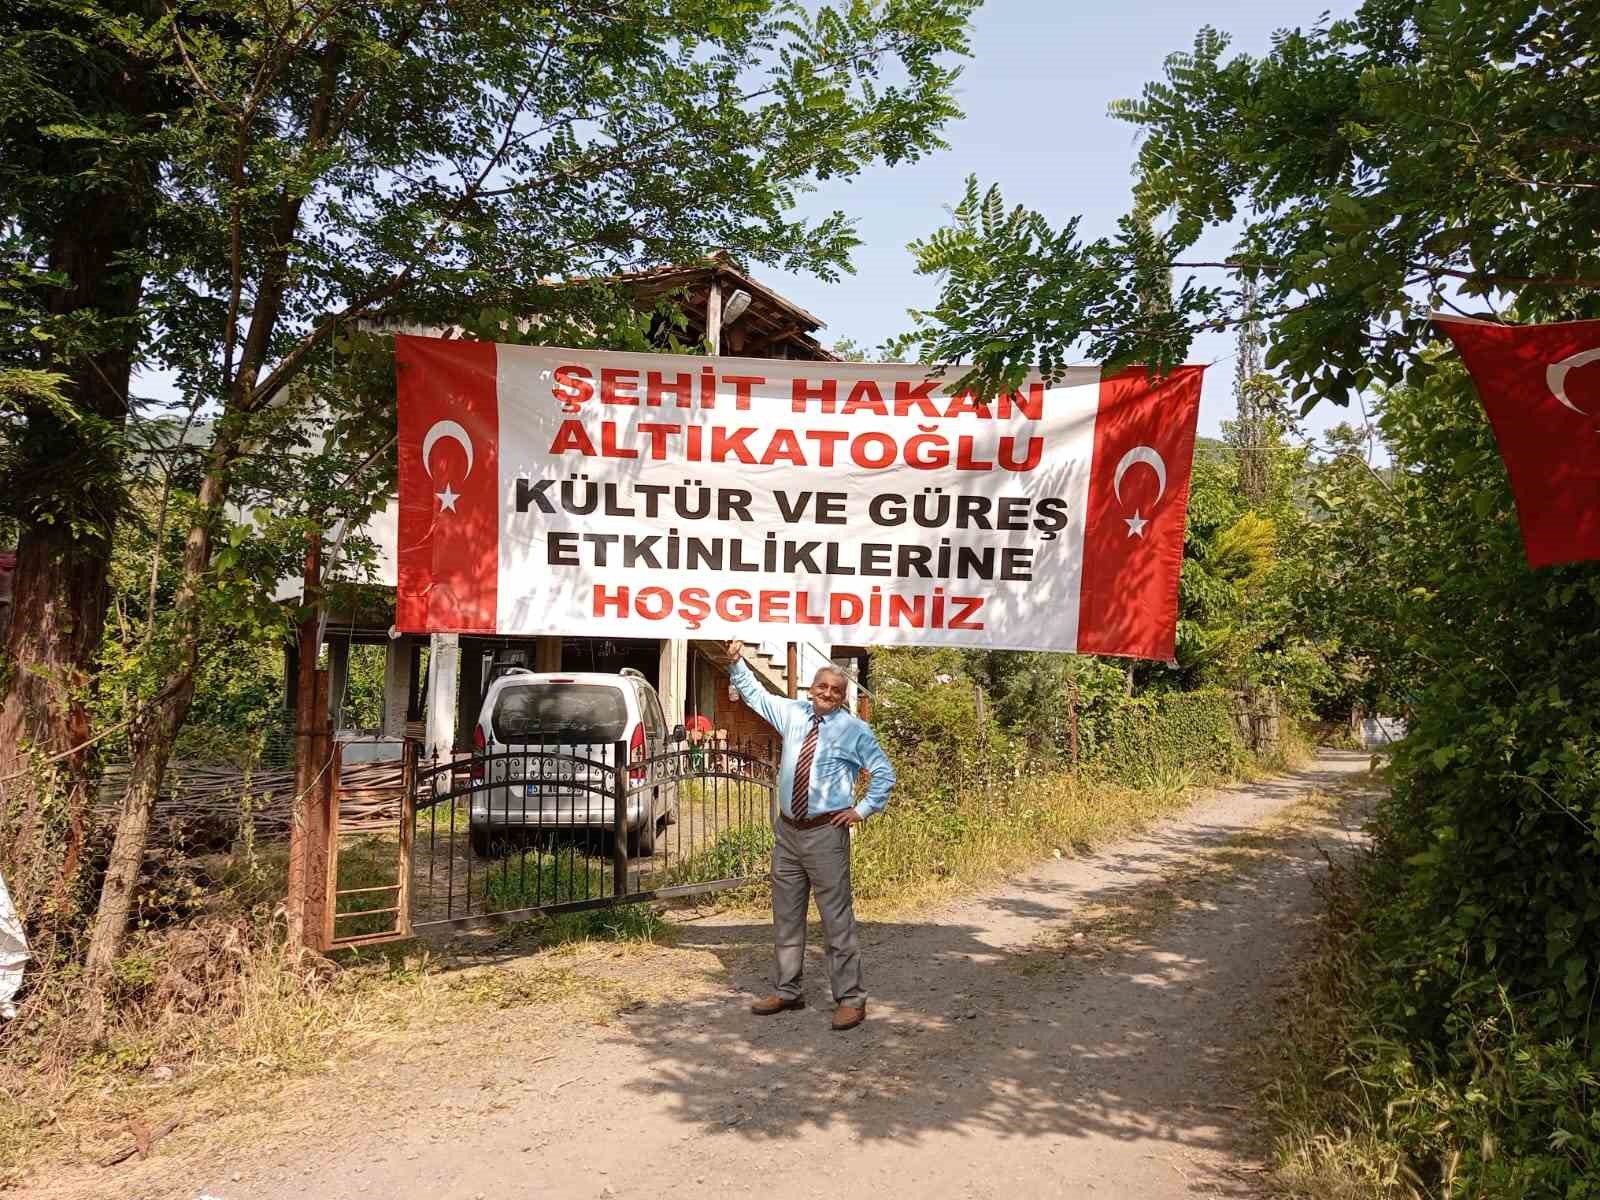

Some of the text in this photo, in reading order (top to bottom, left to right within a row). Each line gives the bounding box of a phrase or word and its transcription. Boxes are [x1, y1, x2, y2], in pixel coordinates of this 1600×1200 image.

[552, 365, 1044, 420] ŞEHİT HAKAN
[549, 419, 1044, 472] ALTIKATOĞLU
[516, 473, 1067, 540] KÜLTÜR VE GÜREŞ
[547, 528, 1034, 581] ETKİNLİKLERİNE
[593, 584, 984, 629] HOŞGELDİNİZ
